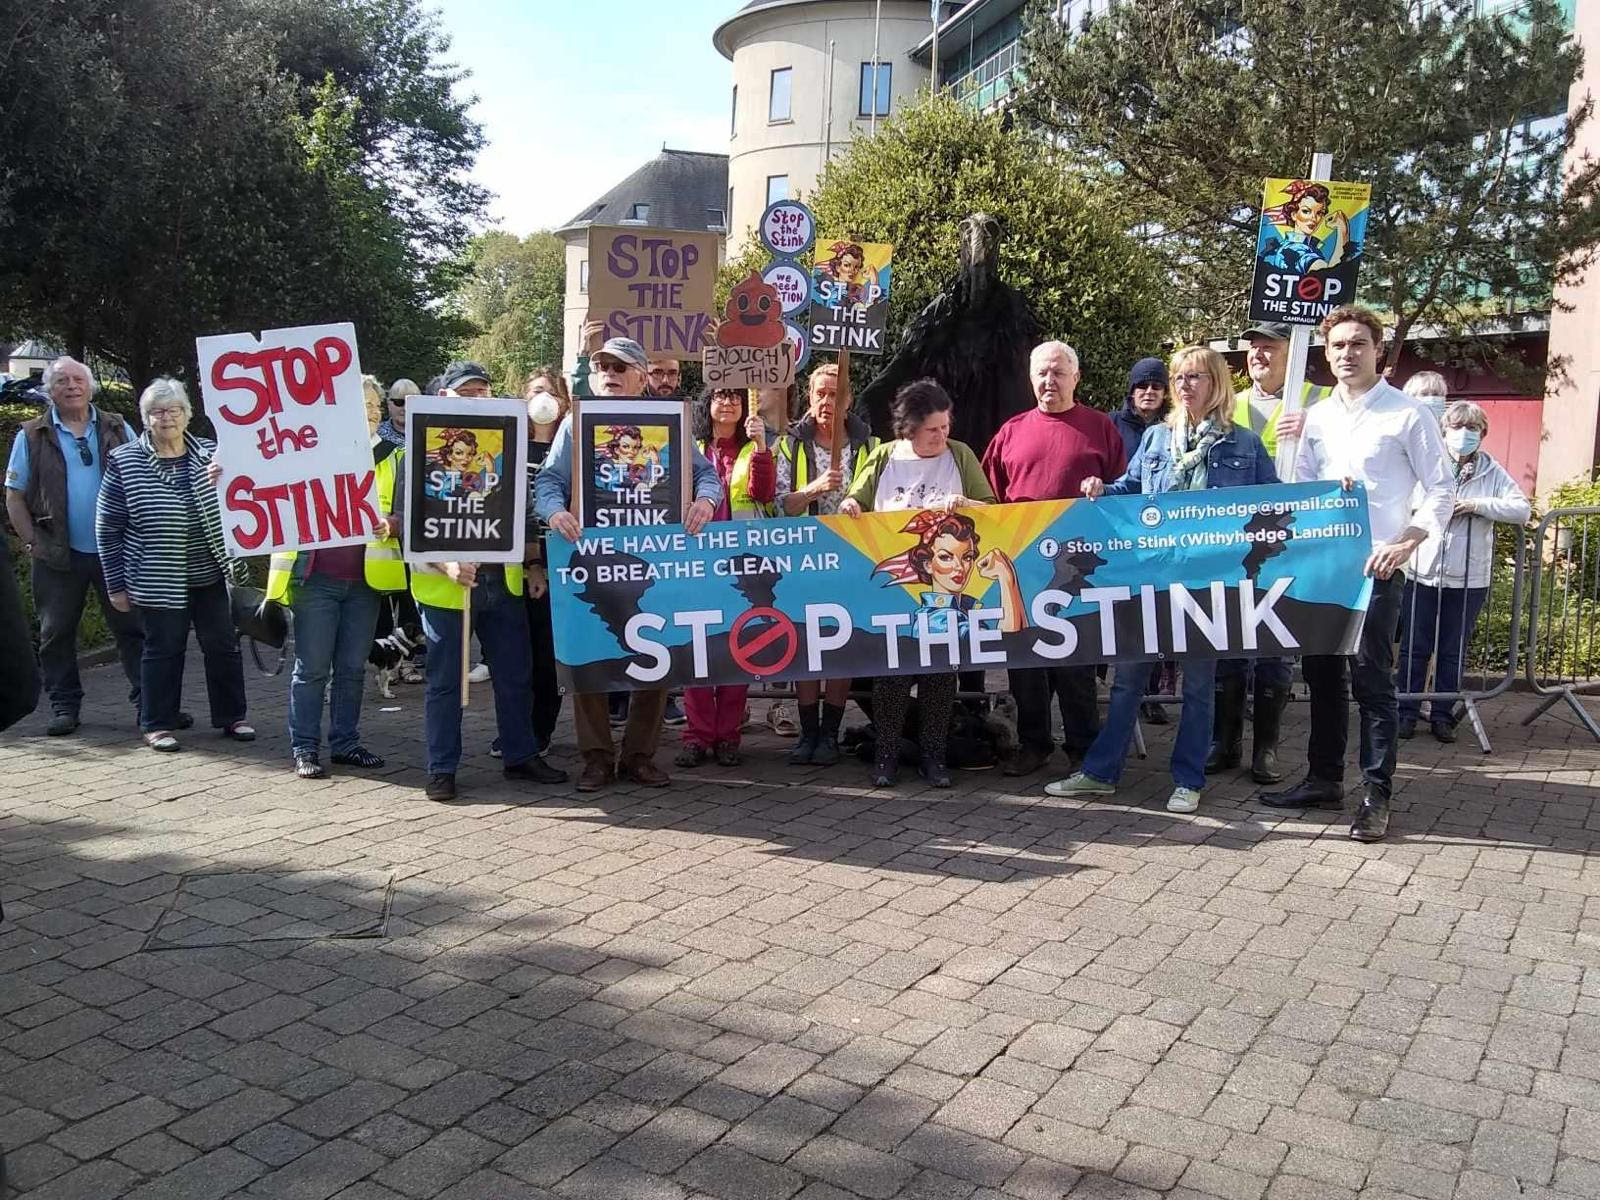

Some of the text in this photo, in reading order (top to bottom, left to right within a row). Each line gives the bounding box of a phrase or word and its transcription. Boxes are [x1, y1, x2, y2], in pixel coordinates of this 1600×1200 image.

[771, 209, 804, 228] Stop
[771, 231, 804, 247] Stink
[780, 225, 798, 235] the
[776, 273, 792, 283] we
[628, 282, 684, 309] THE
[778, 291, 803, 303] TION
[831, 305, 868, 324] THE
[1262, 299, 1288, 313] THE
[1282, 315, 1317, 324] CAMPAIGN
[602, 310, 714, 353] STINK
[812, 324, 881, 349] STINK
[705, 348, 778, 367] ENOUGH
[211, 336, 352, 425] STOP
[708, 366, 779, 385] OF THIS
[256, 416, 318, 460] the
[445, 497, 484, 514] THE
[612, 487, 652, 505] THE
[226, 470, 382, 550] STINK
[595, 508, 669, 528] STINK
[1167, 496, 1359, 520] wiffyhedge@gmail.com
[423, 517, 502, 539] STINK
[576, 526, 818, 556] WE HAVE THE RIGHT
[1067, 540, 1103, 554] Stop
[1108, 537, 1132, 551] the
[1137, 534, 1177, 549] Stink
[1180, 527, 1287, 548] (Withyhedge
[1292, 523, 1362, 540] Landfill)
[556, 552, 840, 585] TO BREATHE CLEAN AIR
[871, 607, 1008, 669] THE
[1031, 576, 1301, 660] STINK
